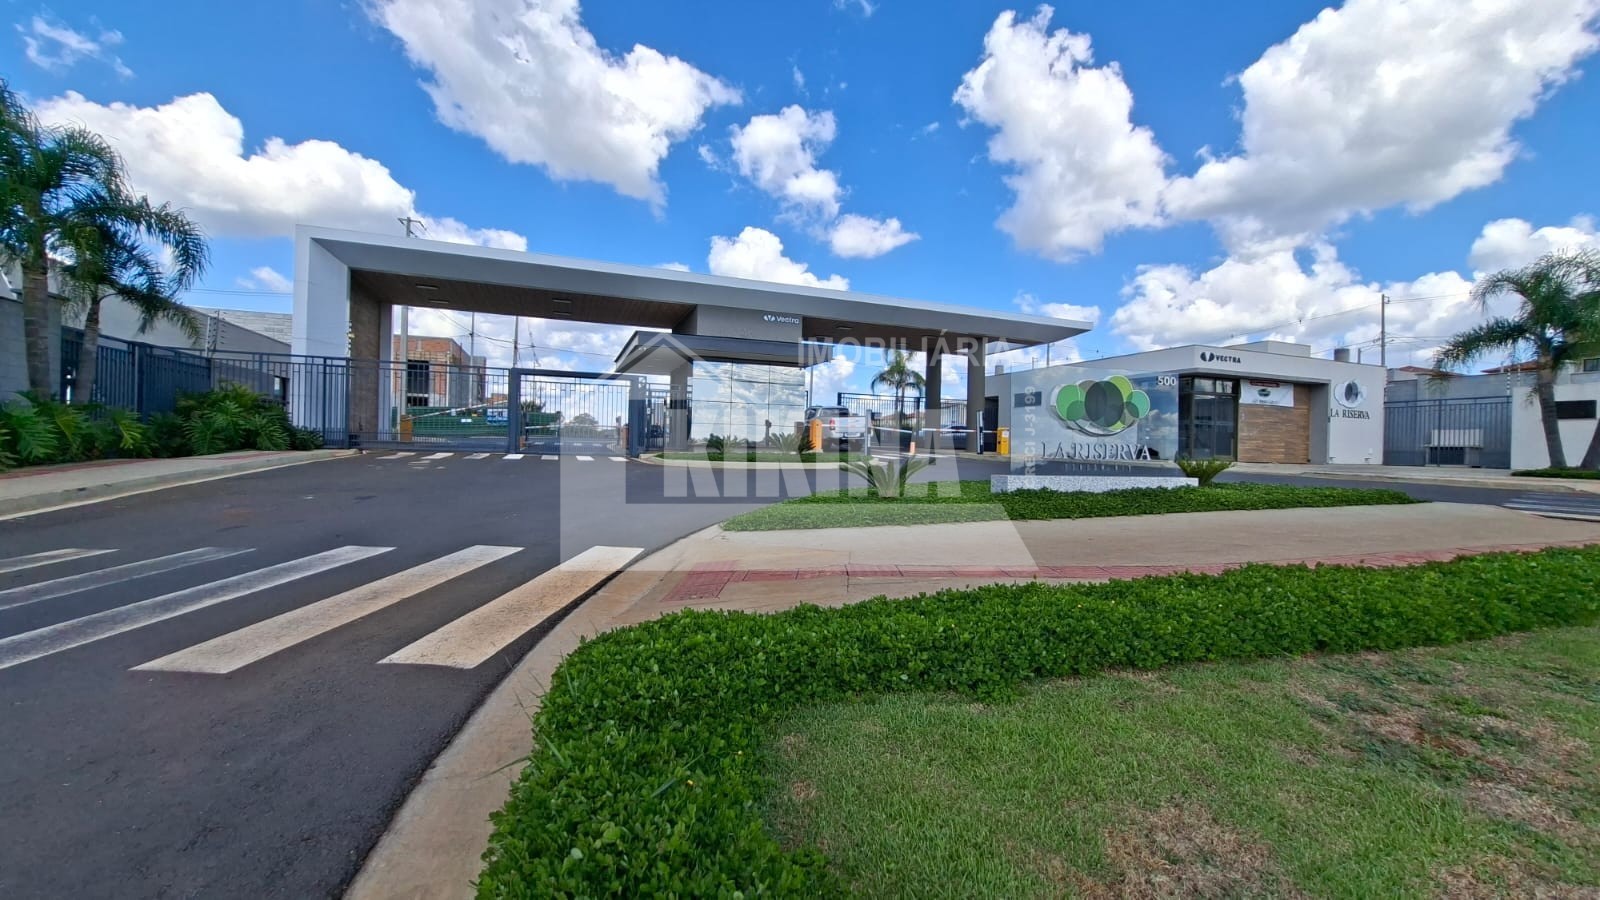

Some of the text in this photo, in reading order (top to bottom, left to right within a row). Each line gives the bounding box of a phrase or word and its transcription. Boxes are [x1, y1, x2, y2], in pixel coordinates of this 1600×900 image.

[776, 315, 800, 324] Vectra
[1215, 354, 1241, 364] VECTRA
[1157, 375, 1177, 386] 500
[1330, 408, 1370, 420] LA RISERVA
[1041, 441, 1152, 461] LA RISERVA
